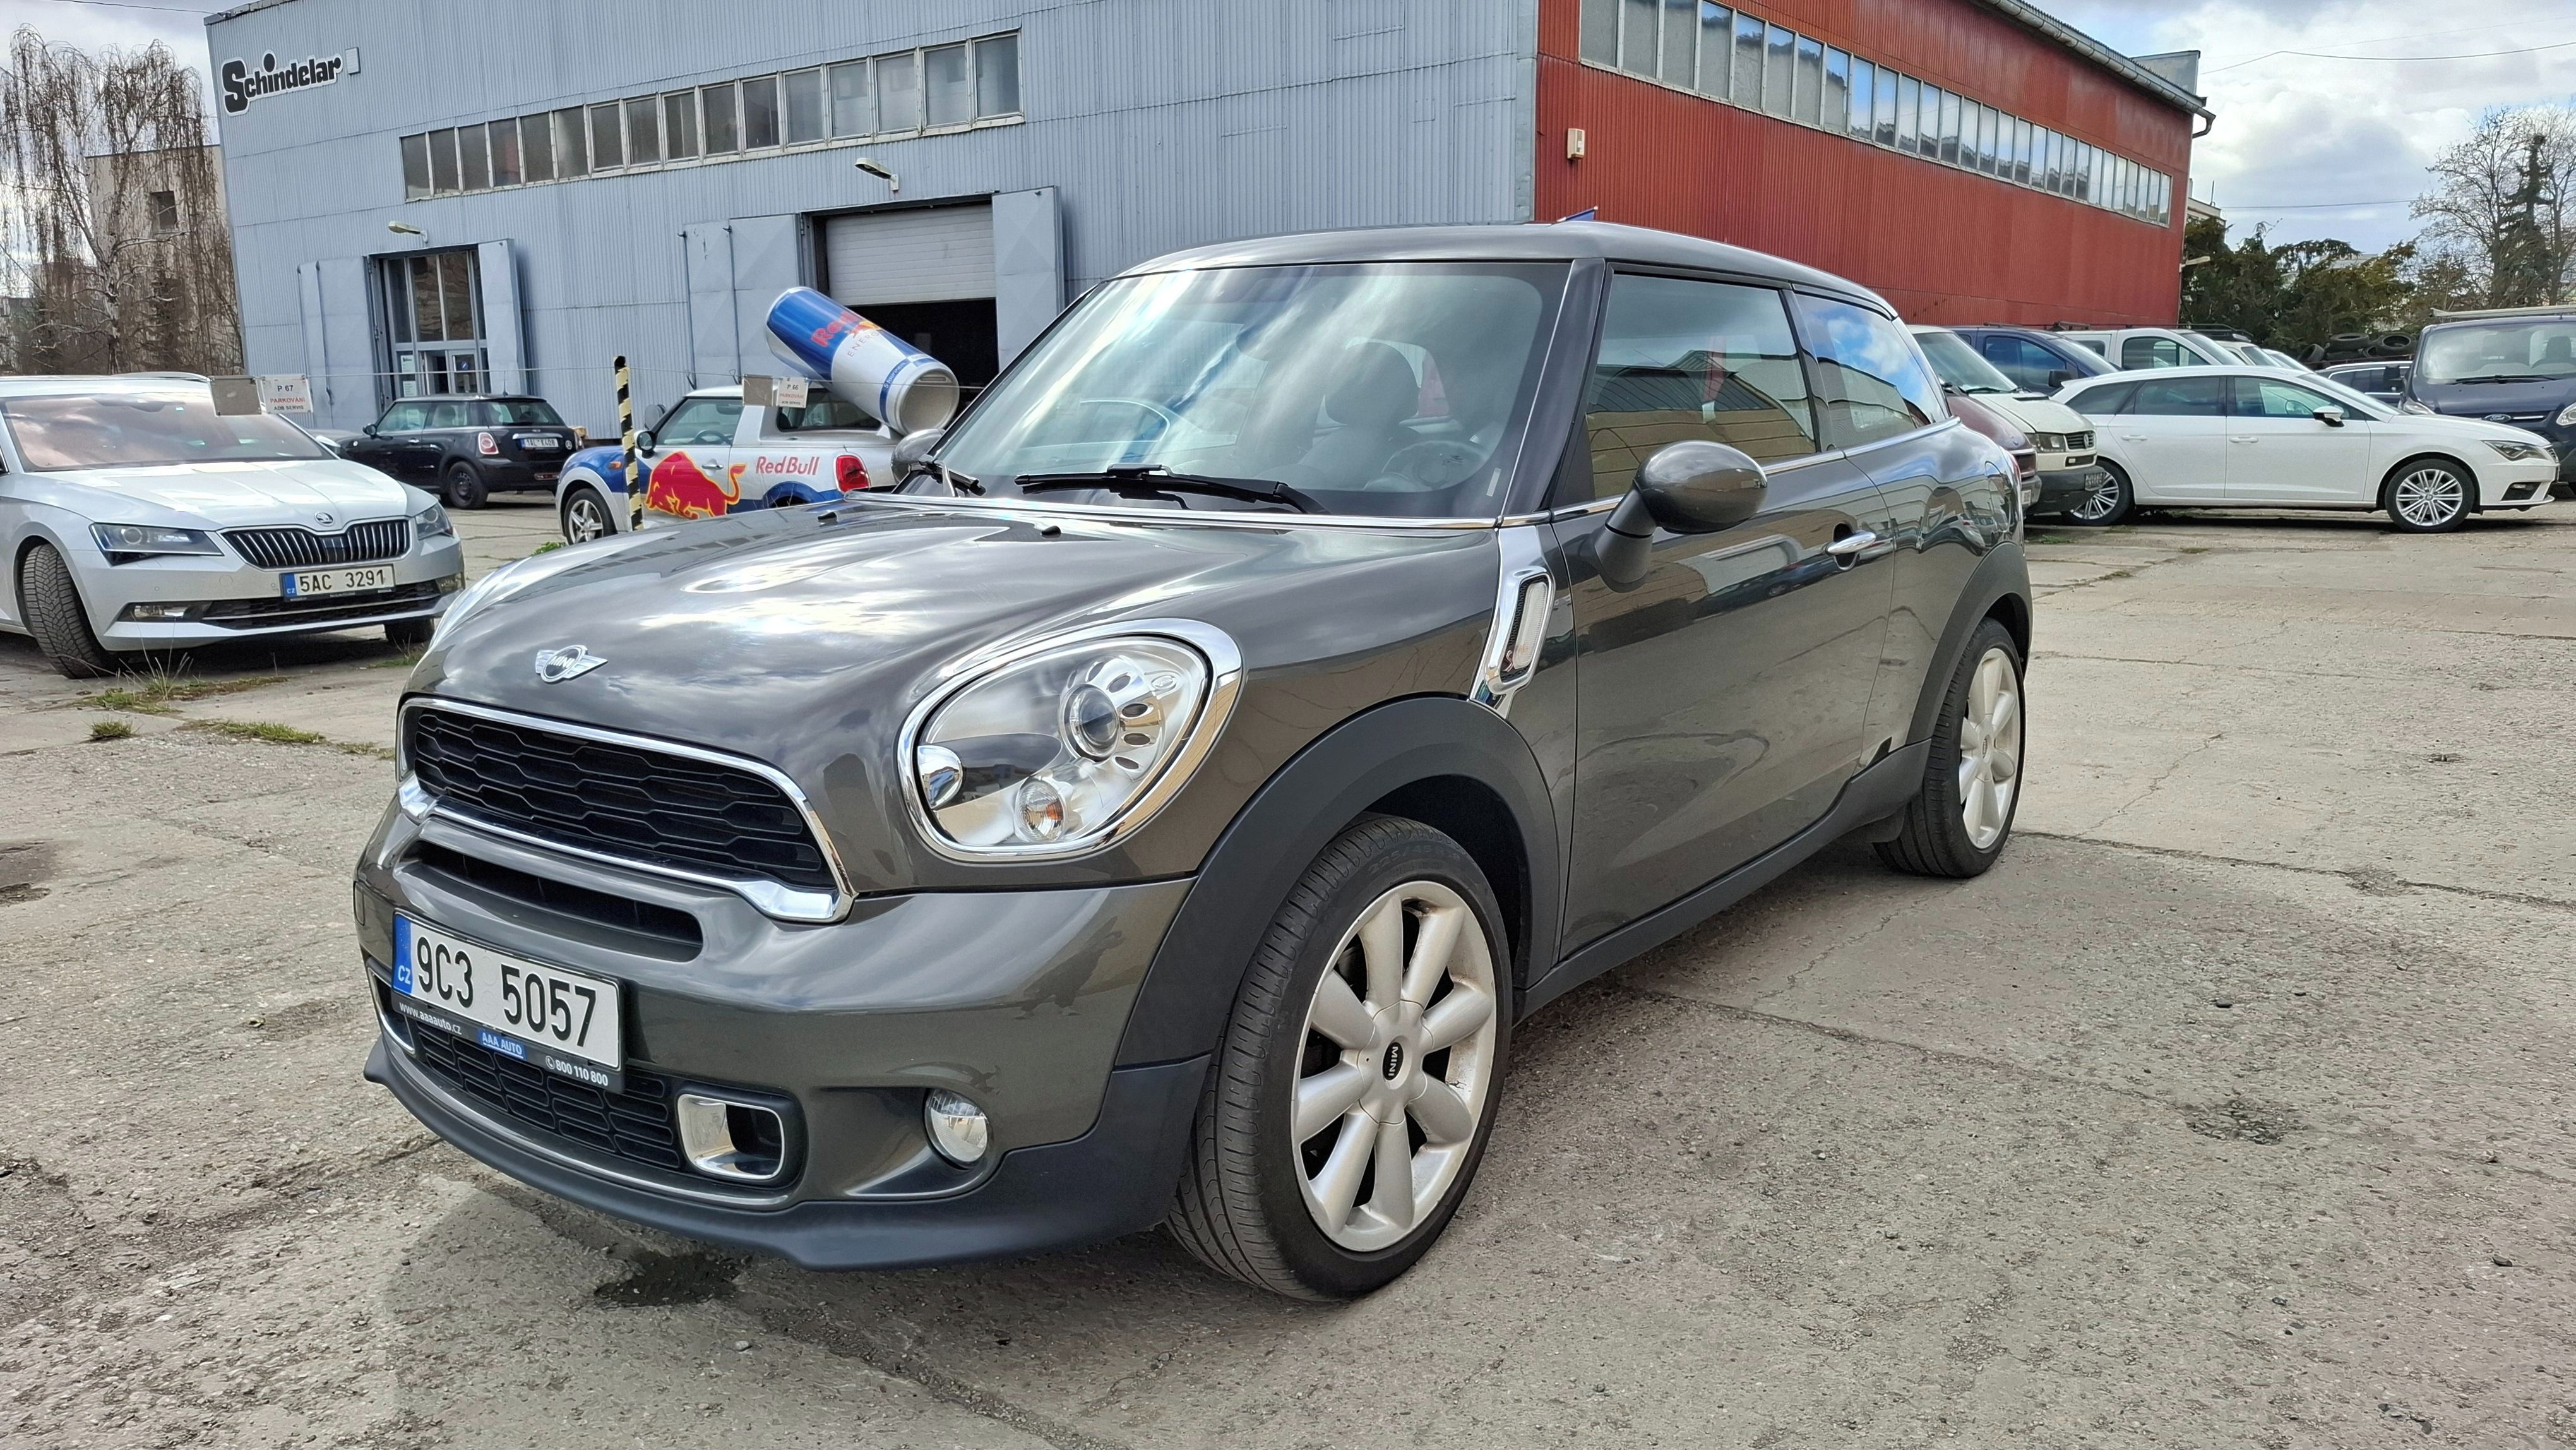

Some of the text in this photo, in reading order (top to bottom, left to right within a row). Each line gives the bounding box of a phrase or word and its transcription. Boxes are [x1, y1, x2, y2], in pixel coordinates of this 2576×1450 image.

[222, 52, 342, 113] Schindelar
[811, 309, 859, 347] Red
[755, 455, 820, 476] Red Bull
[299, 569, 385, 592] 5AC 3291
[398, 965, 411, 985] CZ
[417, 937, 597, 1048] 9C3 5057
[399, 1002, 462, 1035] www.aaaauto.cz
[482, 1032, 522, 1055] AAA AUTO
[556, 1060, 608, 1086] 800 110 800
[1388, 1046, 1398, 1076] MINI
